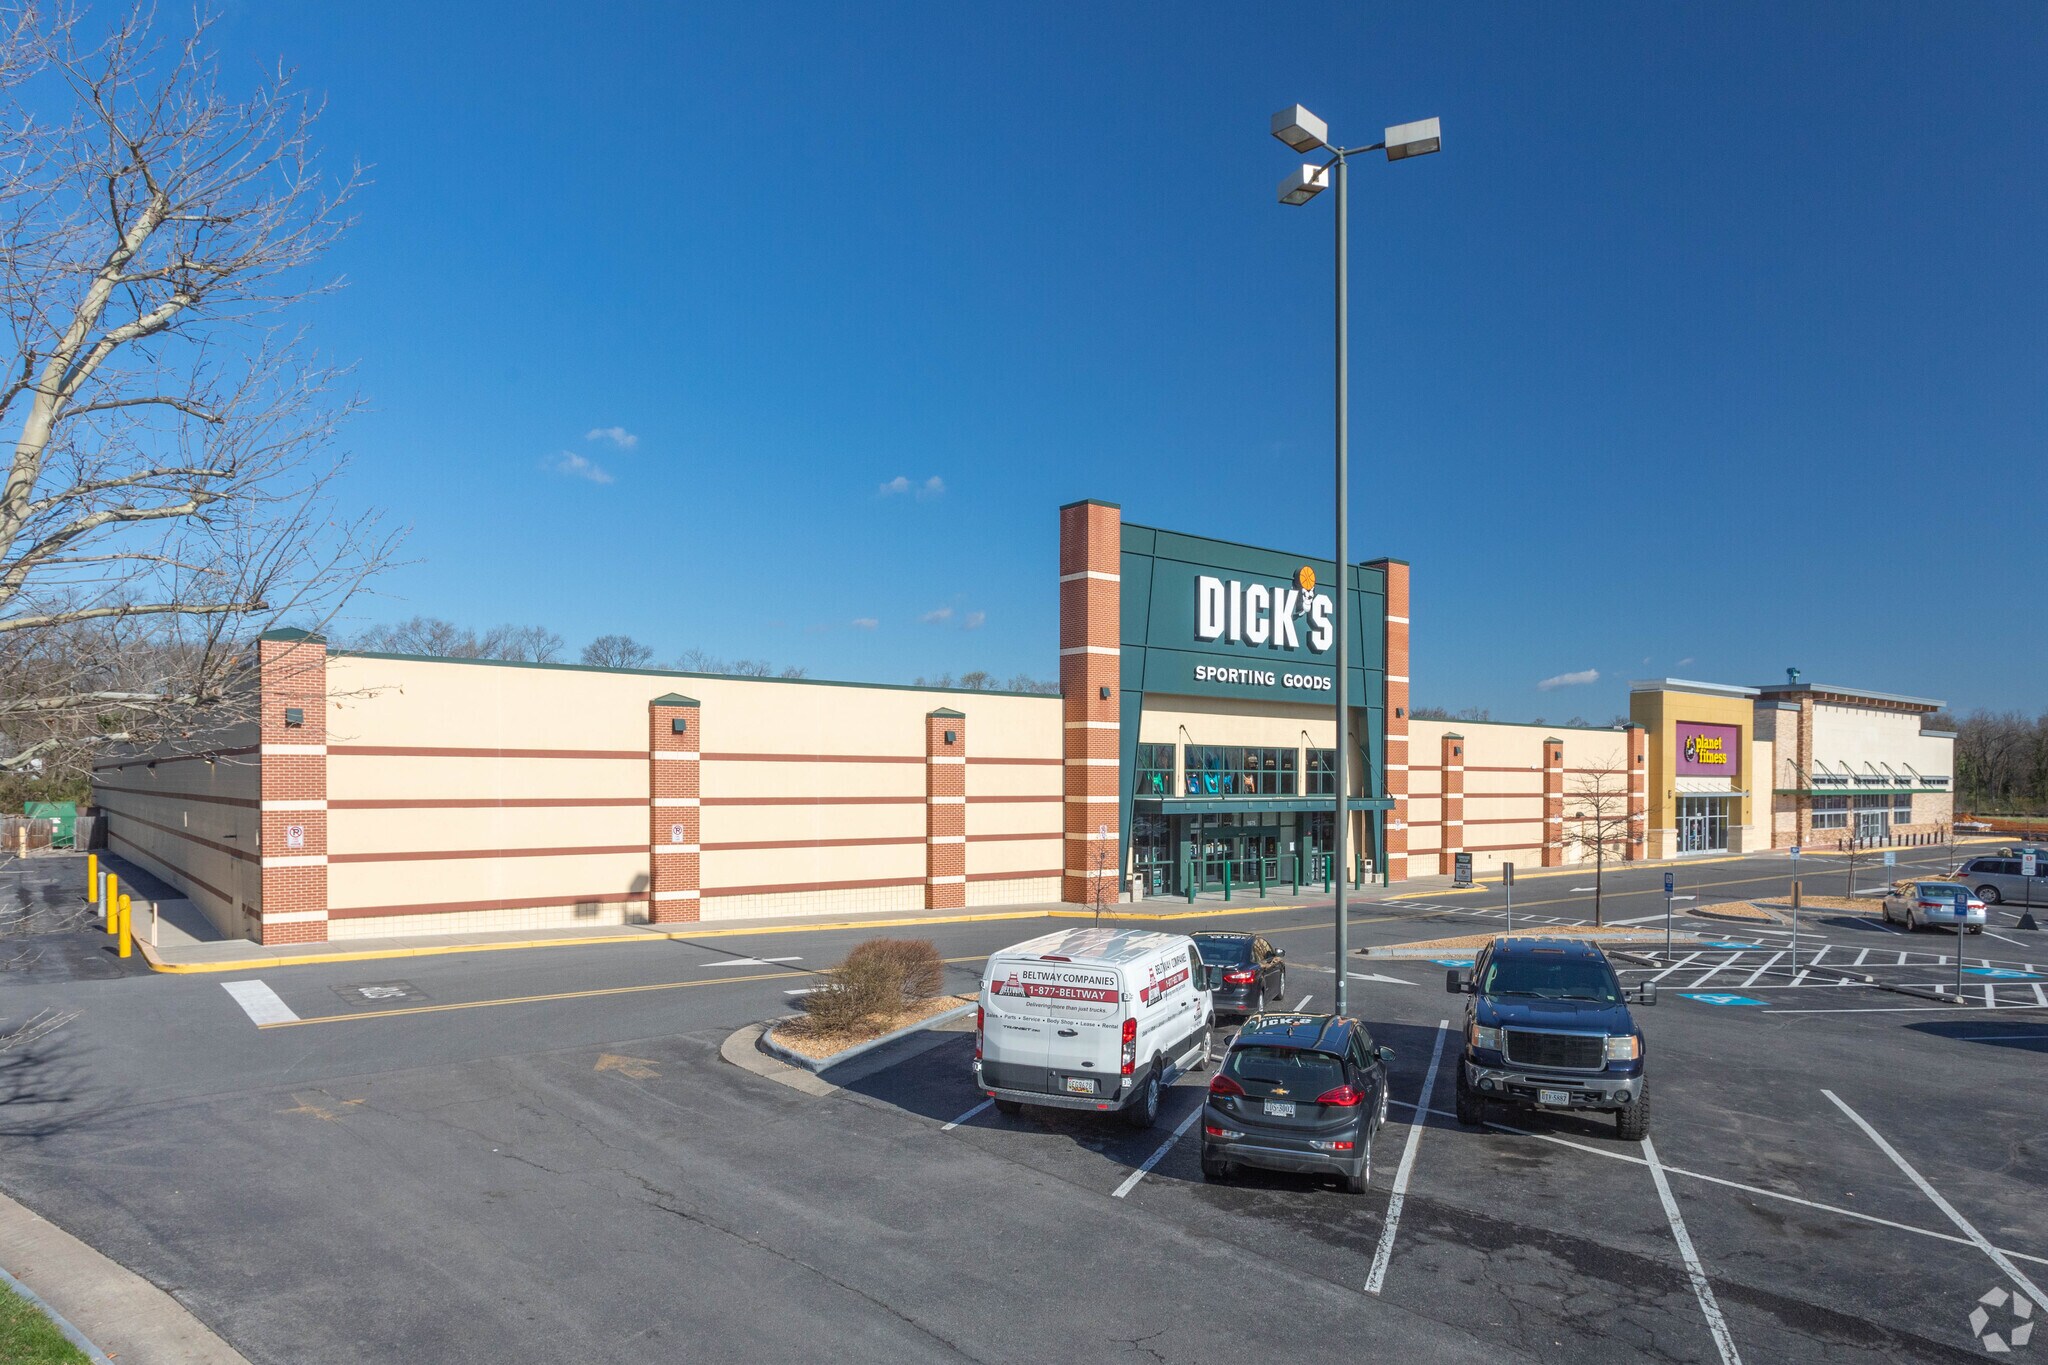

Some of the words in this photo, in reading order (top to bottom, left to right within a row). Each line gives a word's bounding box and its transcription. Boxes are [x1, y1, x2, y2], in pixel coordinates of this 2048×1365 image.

[1196, 572, 1333, 653] DICK'S
[1195, 666, 1275, 686] SPORTING
[1283, 673, 1332, 691] GOODS
[1695, 734, 1722, 752] planet
[1698, 749, 1727, 764] fitness
[1022, 970, 1062, 982] BELTWAY
[1062, 973, 1115, 986] COMPANIES
[1028, 985, 1106, 1000] 1-877-BELTWAY
[1025, 1001, 1052, 1010] Delivering
